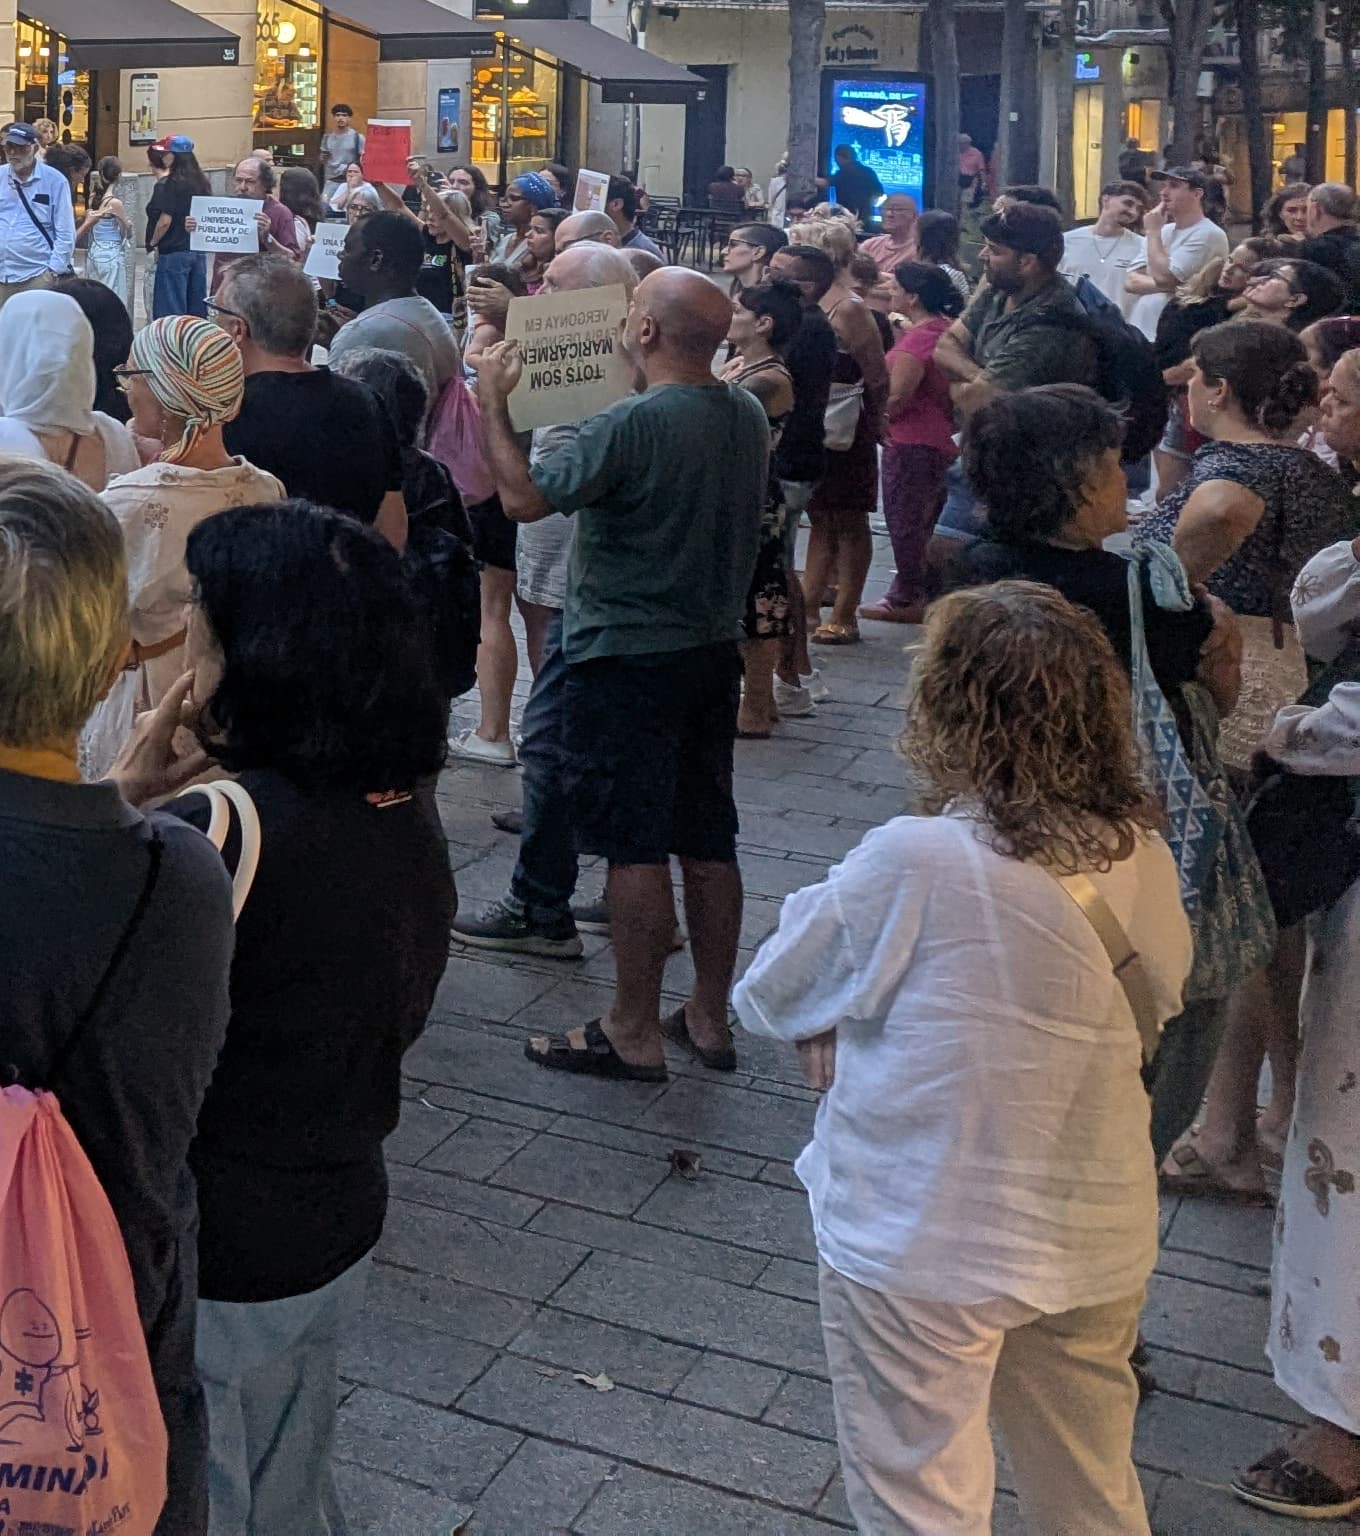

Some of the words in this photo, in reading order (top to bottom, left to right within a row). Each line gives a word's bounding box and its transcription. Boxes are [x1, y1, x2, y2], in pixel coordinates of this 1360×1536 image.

[207, 207, 243, 215] VIVIENDA
[201, 216, 247, 225] UNIVERSAL
[198, 224, 229, 234] PÚBLICA
[238, 227, 249, 235] DE
[205, 235, 239, 244] CALIDAD
[519, 337, 613, 365] MARICARMEN
[530, 369, 562, 389] SOM
[566, 364, 603, 383] TOTS
